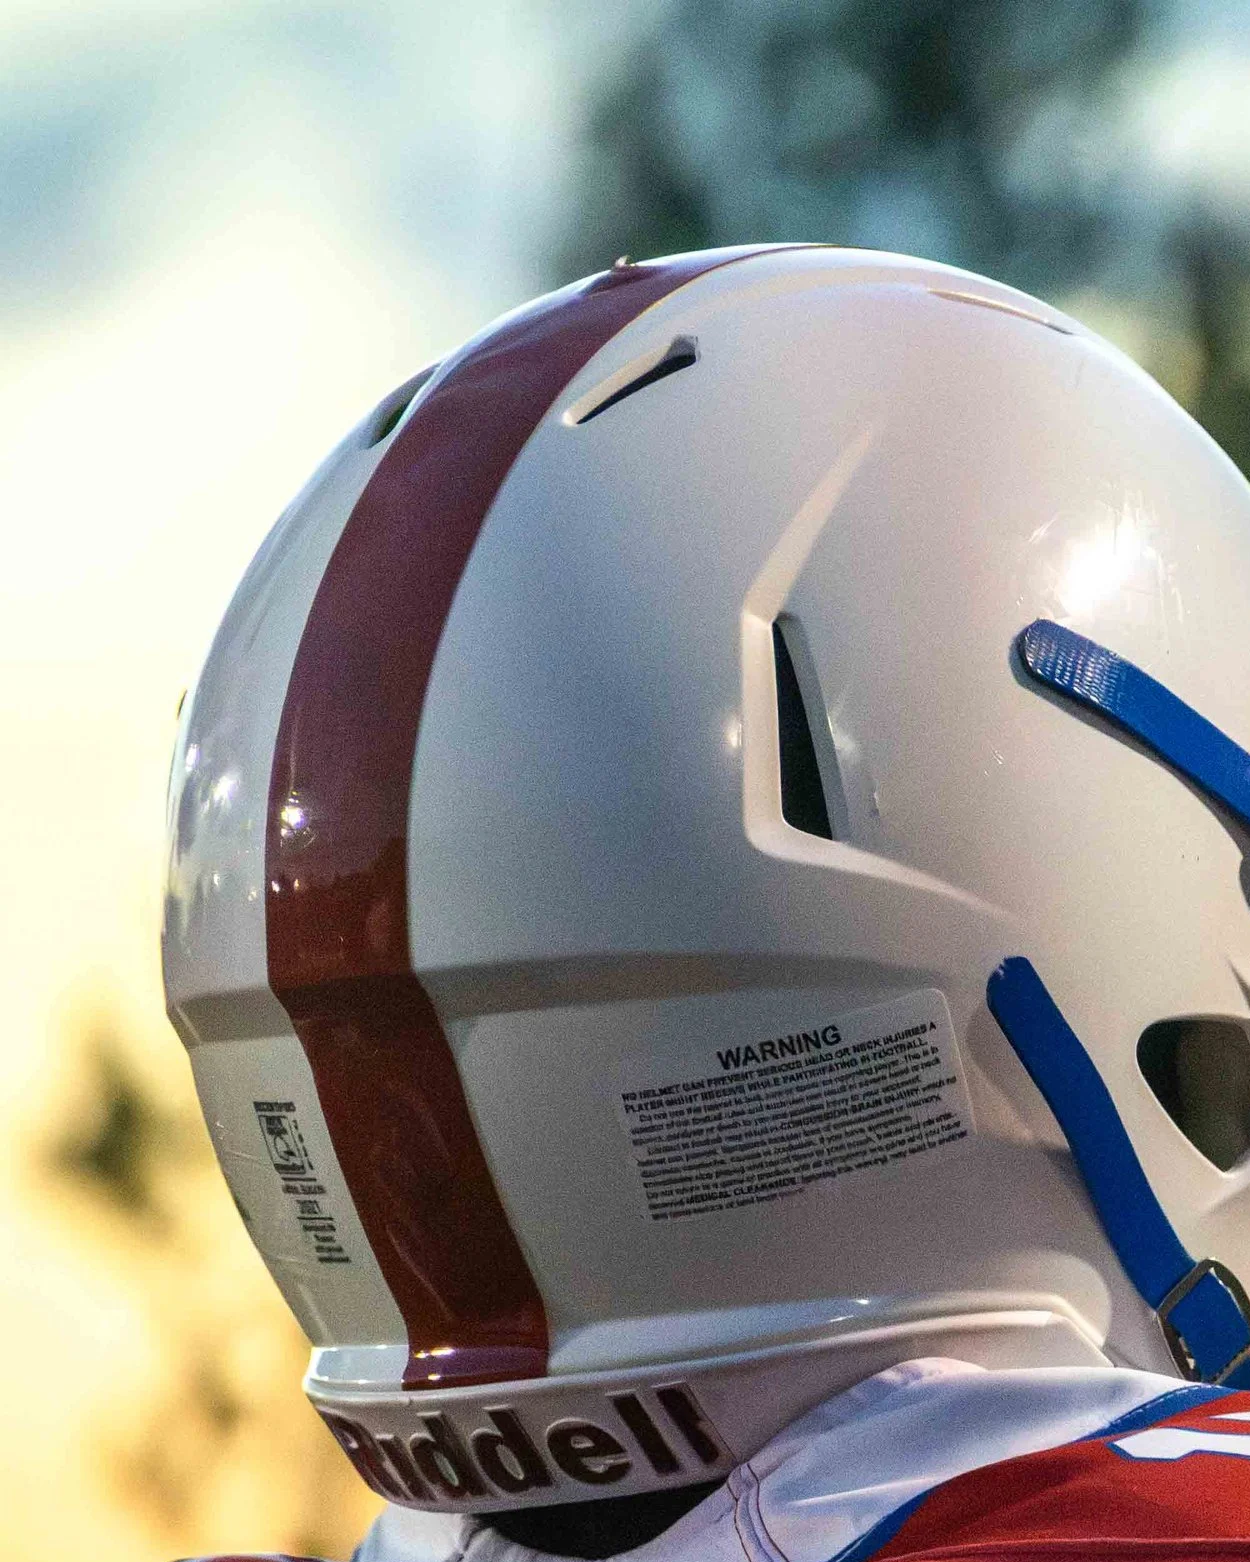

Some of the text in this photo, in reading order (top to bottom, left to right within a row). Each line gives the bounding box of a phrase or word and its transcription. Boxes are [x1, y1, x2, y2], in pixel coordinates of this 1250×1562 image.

[716, 1024, 842, 1071] WARNING
[623, 1098, 664, 1113] PLAYER
[320, 1384, 722, 1502] Riddell
